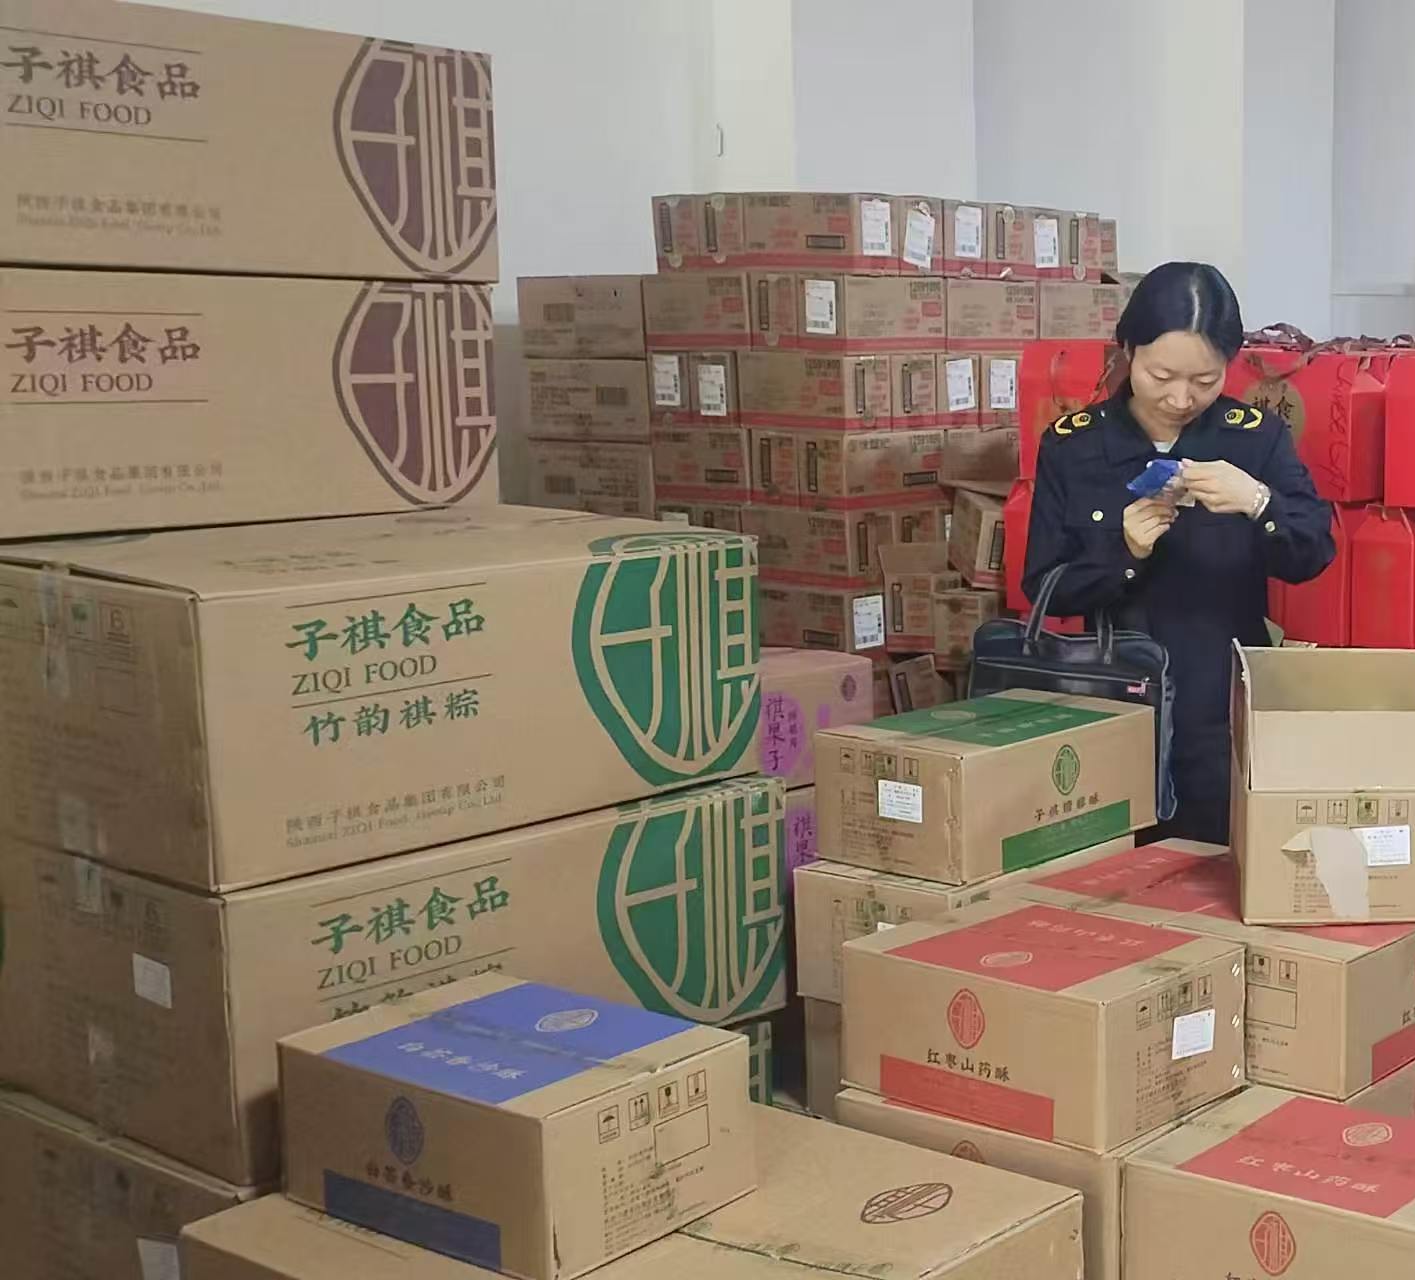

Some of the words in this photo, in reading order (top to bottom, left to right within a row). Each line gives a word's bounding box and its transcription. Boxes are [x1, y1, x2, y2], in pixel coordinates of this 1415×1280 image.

[0, 46, 201, 100] 子祺食品
[7, 94, 65, 121] ZIQI
[79, 101, 152, 125] FOOD
[5, 322, 201, 365] 子祺食品
[10, 373, 68, 397] ZIQI
[81, 373, 154, 393] FOOD
[284, 597, 487, 662] 子祺食品
[291, 667, 352, 696] ZIQI
[365, 654, 438, 684] FOOD
[303, 688, 480, 747] 竹韵祺粽
[310, 875, 510, 955] 子祺食品
[317, 956, 376, 991] ZIQI
[390, 934, 463, 971] FOOD
